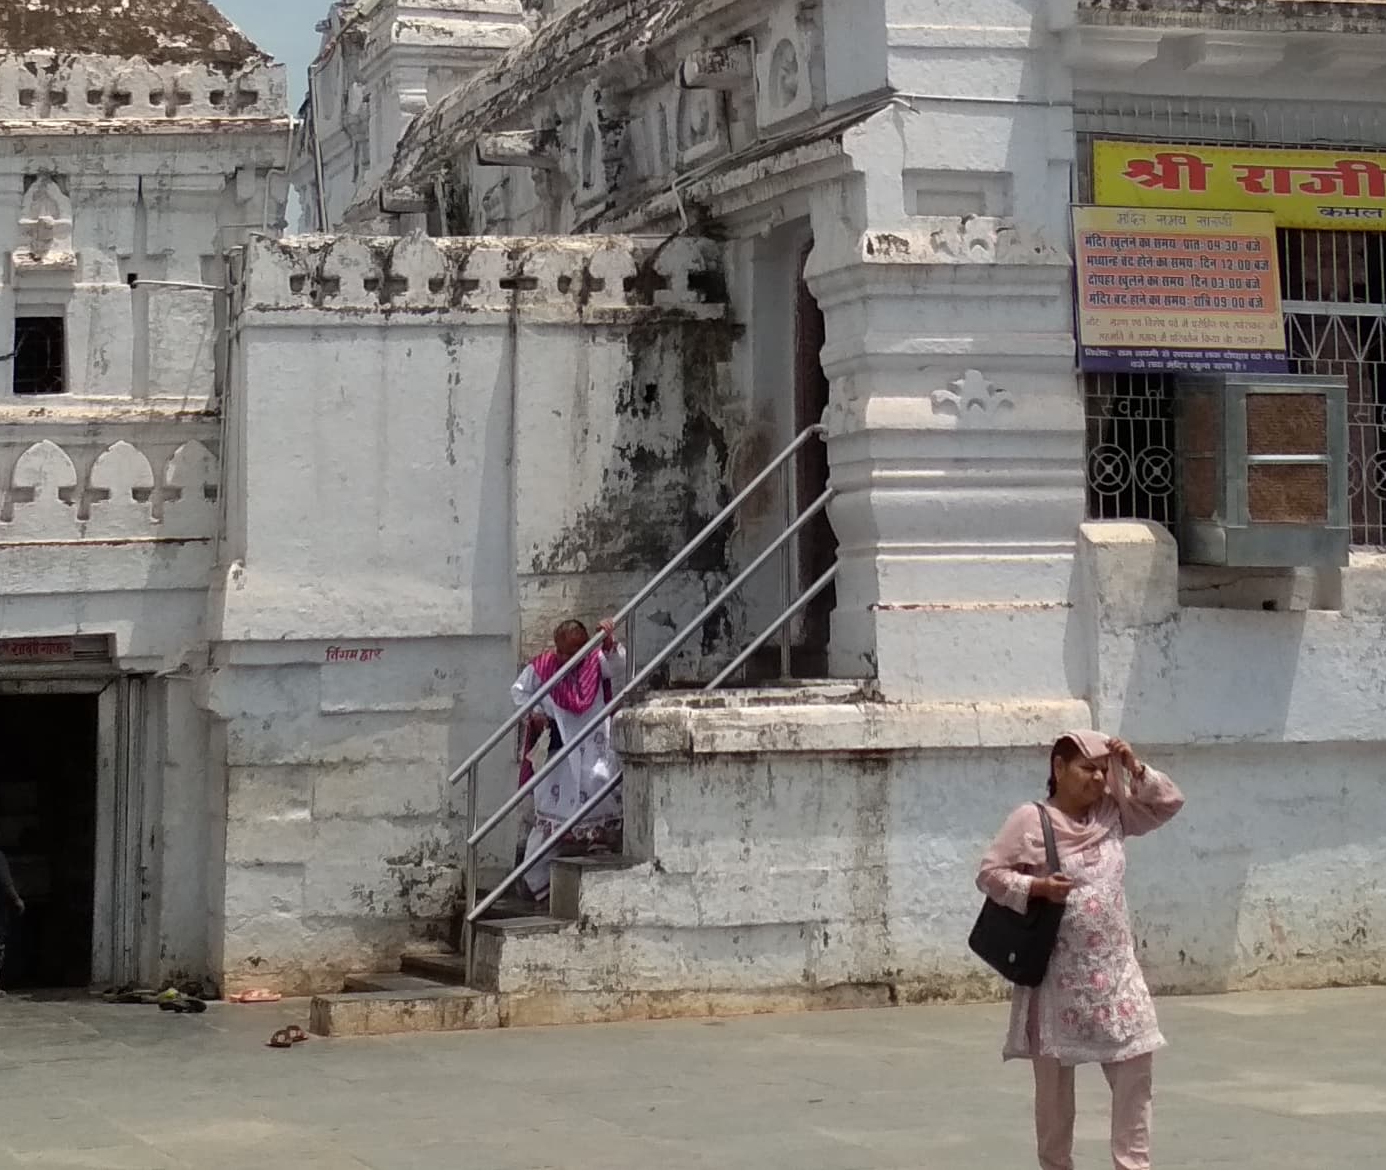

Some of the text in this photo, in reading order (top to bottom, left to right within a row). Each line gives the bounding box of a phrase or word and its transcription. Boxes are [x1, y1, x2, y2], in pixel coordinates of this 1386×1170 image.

[1122, 152, 1213, 192] श्री
[1317, 206, 1384, 220] कमल
[1085, 233, 1107, 248] मंदिर
[1110, 234, 1136, 252] खुलने
[1139, 237, 1151, 248] का
[1246, 238, 1261, 252] बजे
[1137, 254, 1153, 268] होने
[1156, 257, 1168, 268] का
[1200, 255, 1217, 269] दिन
[1254, 259, 1269, 271] बजे
[1088, 272, 1115, 286] दोपहर
[1118, 273, 1144, 290] खुलने
[1147, 275, 1159, 287] का
[1190, 274, 1207, 288] दिन
[1245, 276, 1261, 289] बजे
[1089, 290, 1111, 305] मंदिर
[1149, 294, 1161, 305] का
[1193, 293, 1211, 307] रात्रि
[1248, 295, 1263, 308] बजे
